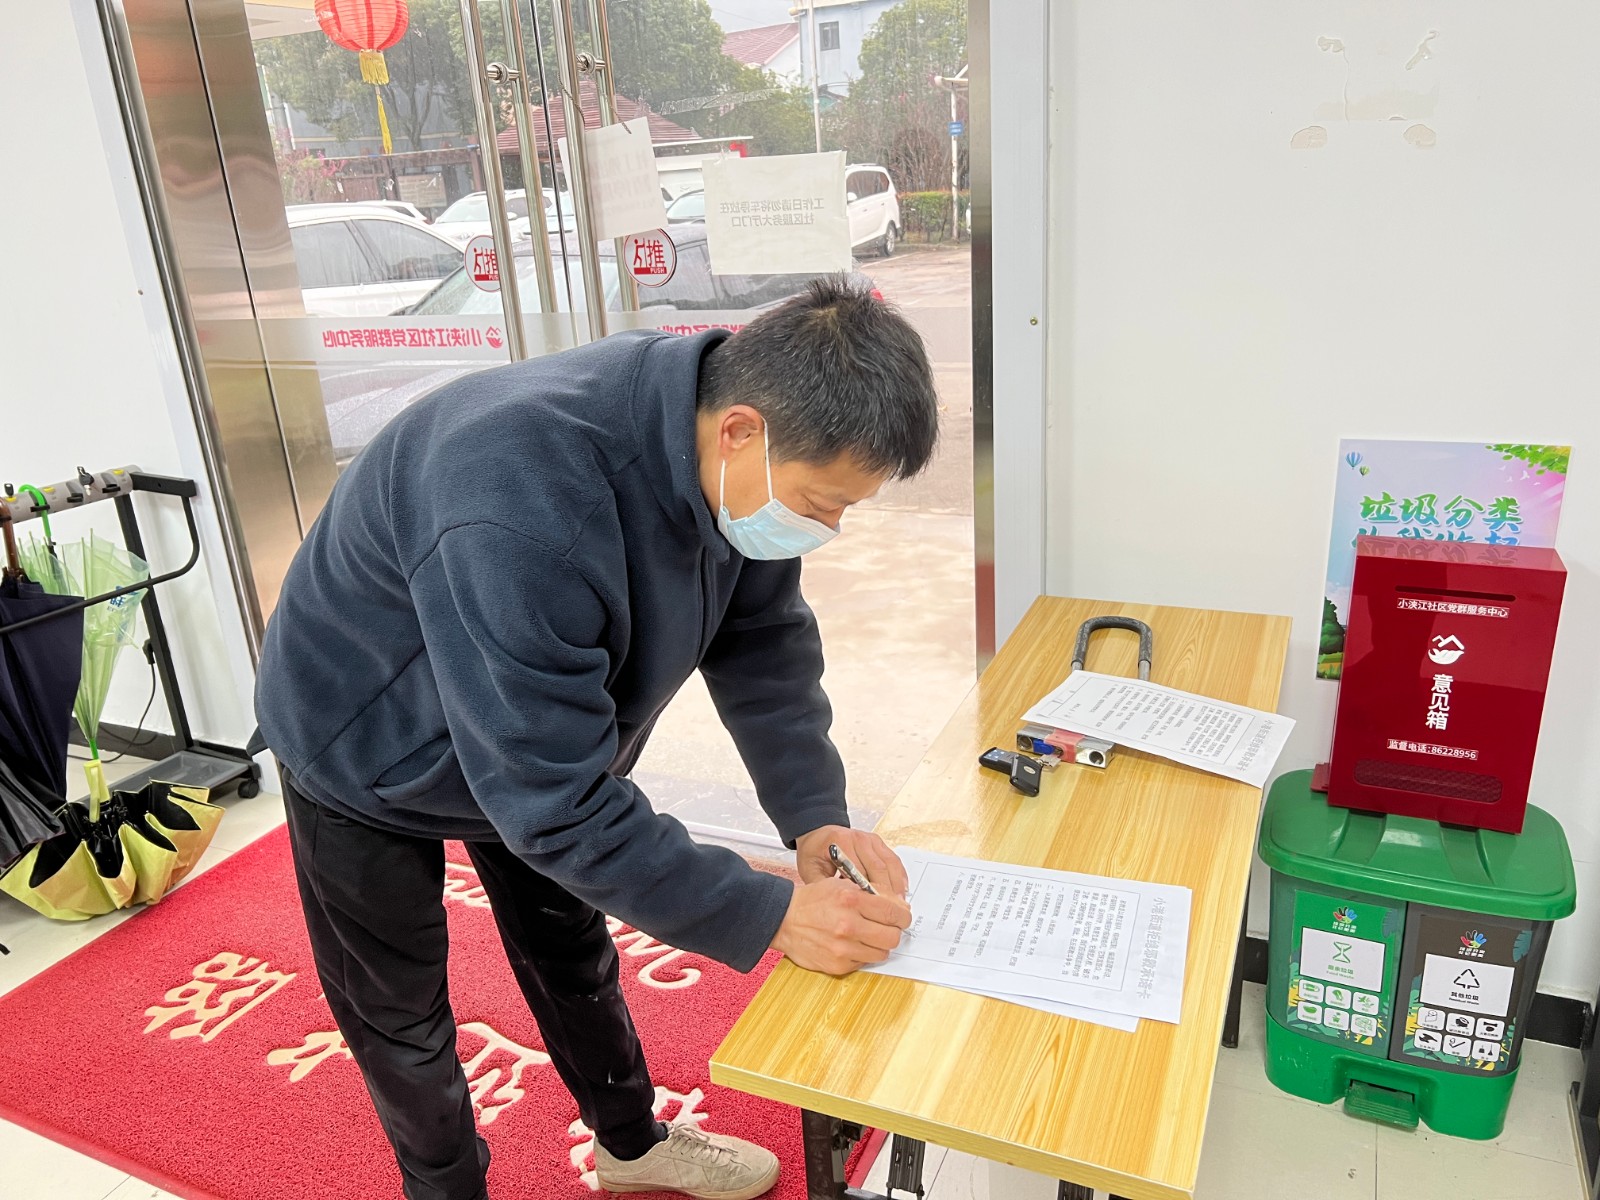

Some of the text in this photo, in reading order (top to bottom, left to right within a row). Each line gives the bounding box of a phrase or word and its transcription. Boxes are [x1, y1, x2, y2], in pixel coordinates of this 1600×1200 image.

[646, 239, 666, 268] 推
[1359, 491, 1523, 534] 垃圾分类
[1397, 598, 1510, 618] 小浃江社区党群服务中心
[1425, 673, 1454, 731] 意见箱
